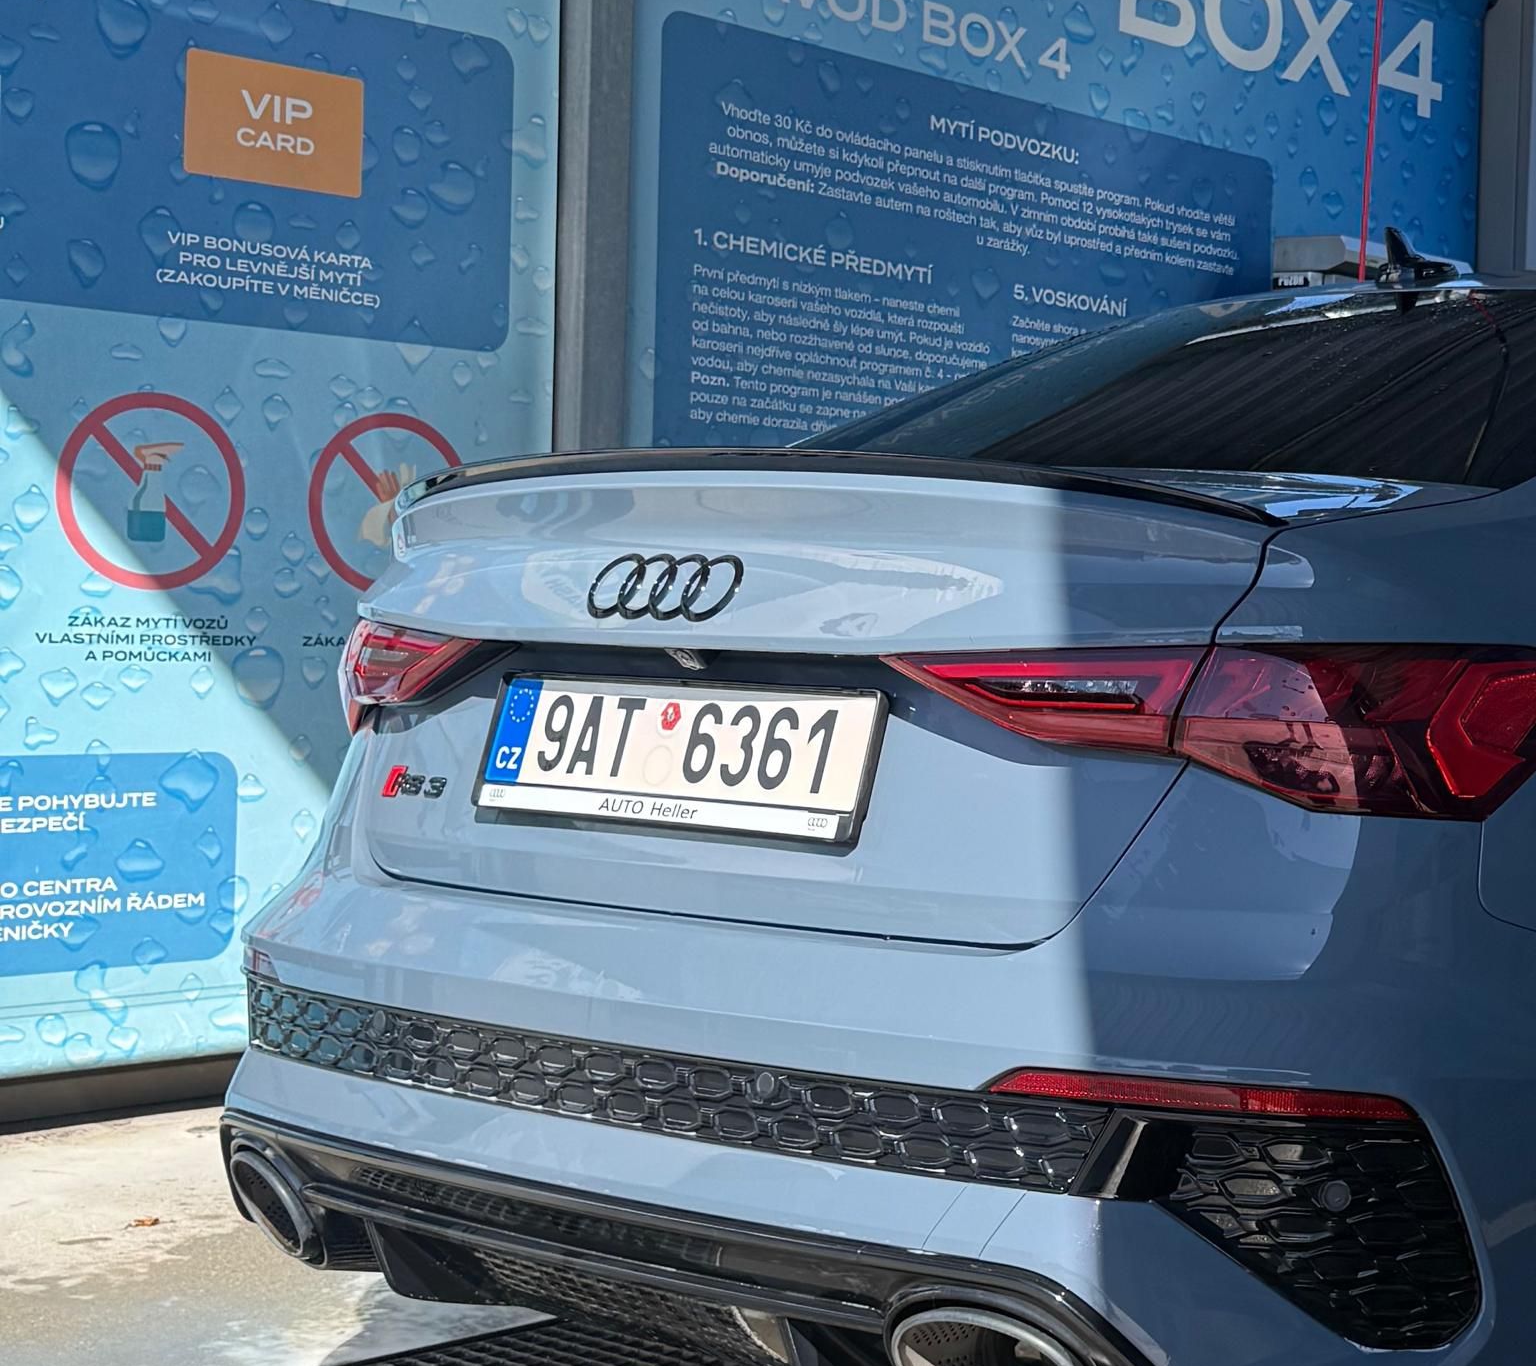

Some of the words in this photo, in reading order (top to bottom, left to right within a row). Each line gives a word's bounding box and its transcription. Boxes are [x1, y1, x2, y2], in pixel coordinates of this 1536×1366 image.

[922, 0, 1028, 65] BOX
[1038, 40, 1072, 80] 4
[1376, 18, 1443, 119] 4
[241, 88, 313, 125] VIP
[236, 126, 315, 157] CARD
[930, 115, 973, 139] MYTÍ
[978, 127, 1080, 165] PODVOZKU:
[829, 147, 838, 159] si
[946, 155, 953, 166] a
[1010, 201, 1018, 216] V
[168, 231, 199, 245] VIP
[204, 236, 310, 261] BONUSOVÁ
[313, 251, 372, 269] KARTA
[694, 228, 707, 246] 1.
[713, 232, 826, 265] CHEMICKÉ
[831, 251, 933, 284] PŘEDMYTÍ
[1115, 245, 1121, 254] a
[179, 252, 220, 268] PRO
[226, 259, 314, 280] LEVNĚJŠÍ
[319, 270, 360, 286] MYTÍ
[156, 269, 273, 293] (ZAKOUPÍTE
[277, 283, 289, 295] V
[294, 284, 380, 307] MĚNIČCE)
[782, 280, 788, 291] s
[1013, 284, 1028, 301] 5.
[1032, 286, 1128, 317] VOSKOVÁNÍ
[68, 613, 131, 627] ZÁKAZ
[136, 614, 177, 629] MYTÍ
[182, 615, 228, 630] VOZŮ
[35, 631, 135, 644] VLASTNÍMI
[139, 631, 257, 646] PROSTŘEDKY
[302, 634, 346, 647] ZÁKA
[85, 651, 97, 661] A
[102, 647, 211, 662] POMŮCKAMI
[538, 695, 647, 779] 9AT
[682, 702, 838, 795] 6361
[495, 746, 522, 770] CZ
[18, 792, 157, 811] POHYBUJTE
[598, 797, 646, 817] AUTO
[651, 801, 699, 820] Heller
[23, 876, 118, 896] CENTRA
[0, 892, 121, 919] ROVOZNÍM
[126, 891, 205, 912] ŘÁDEM
[0, 920, 74, 942] NIČKY
